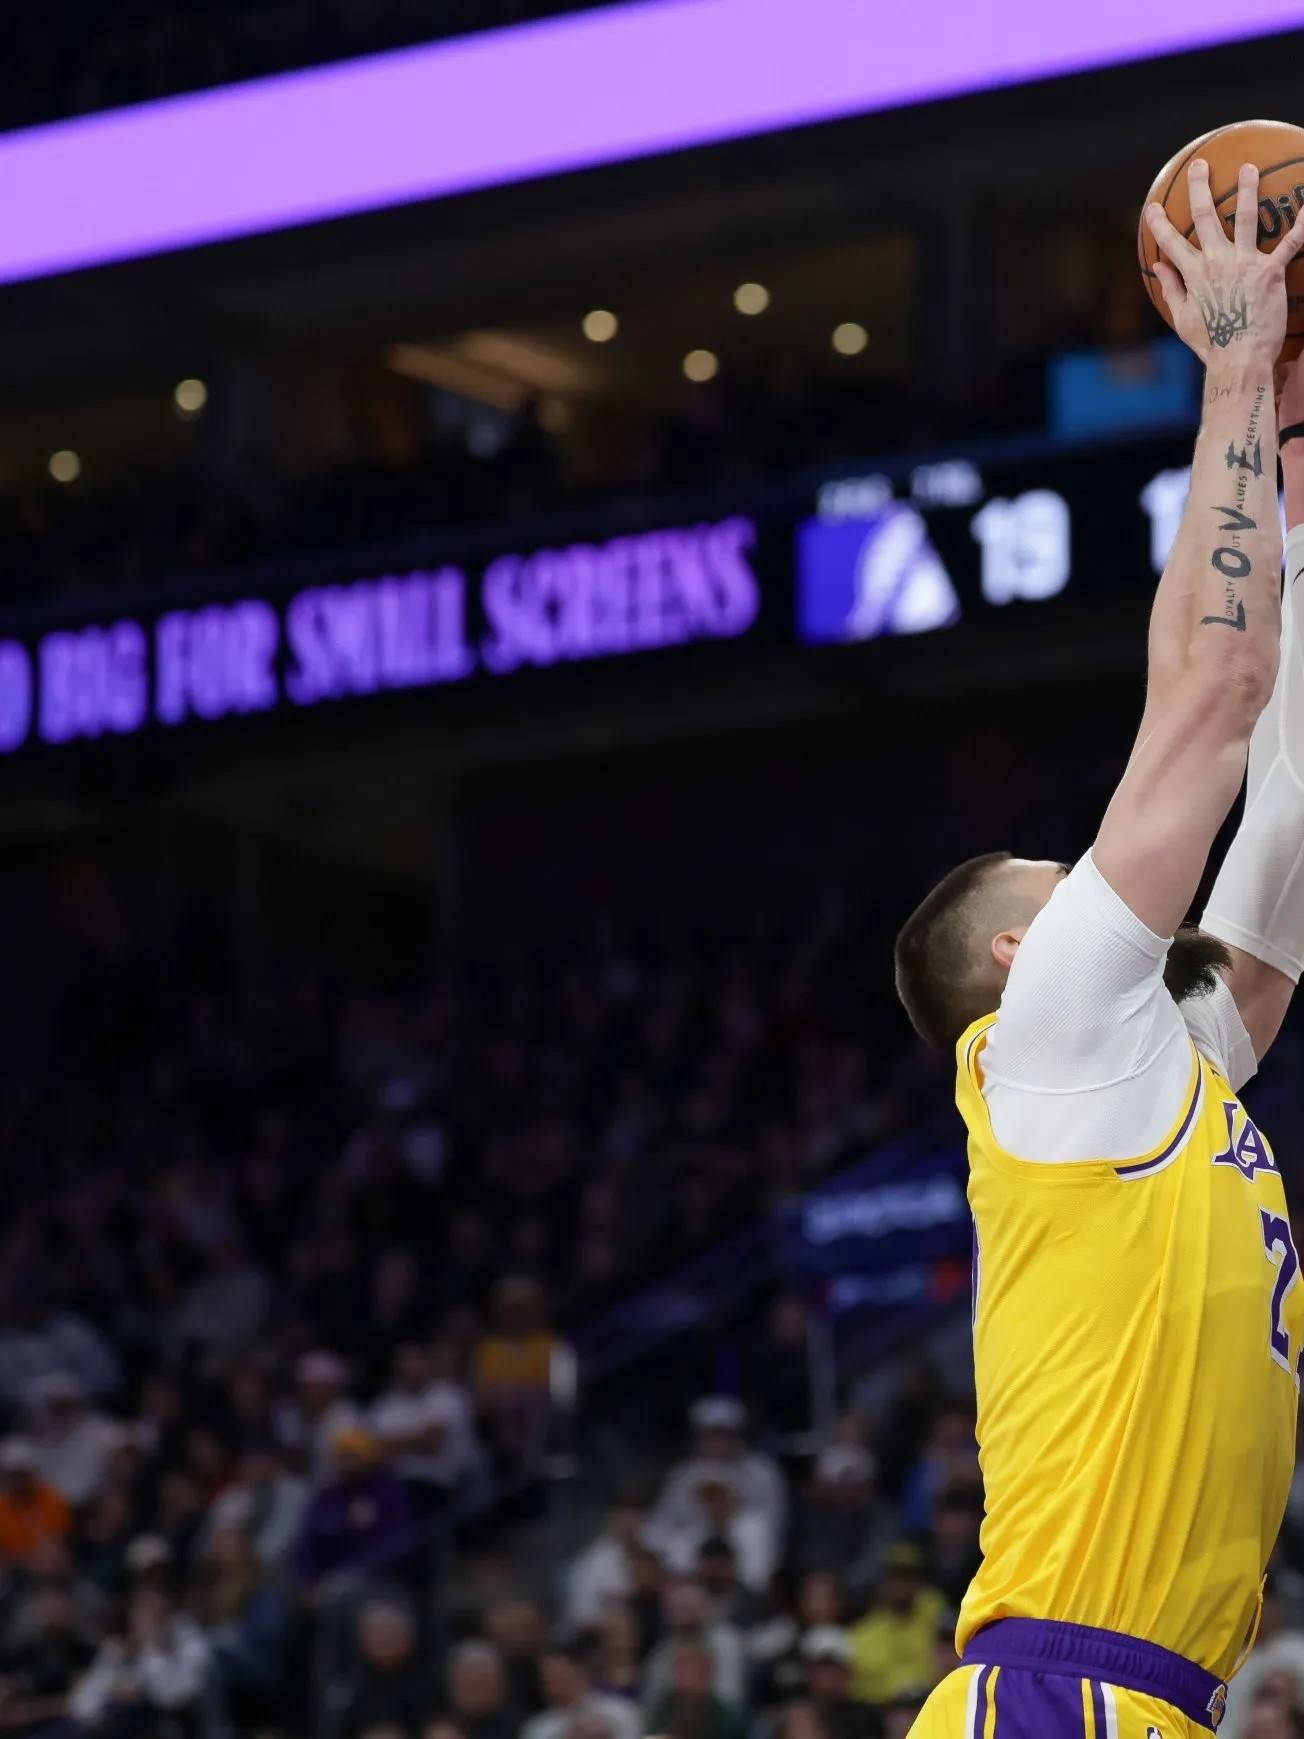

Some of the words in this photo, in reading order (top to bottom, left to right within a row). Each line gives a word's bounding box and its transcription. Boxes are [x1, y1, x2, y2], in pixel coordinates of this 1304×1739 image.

[39, 620, 147, 744] BIG
[154, 600, 278, 725] FOR
[286, 565, 475, 706] SMALL
[480, 514, 760, 674] SCREENS
